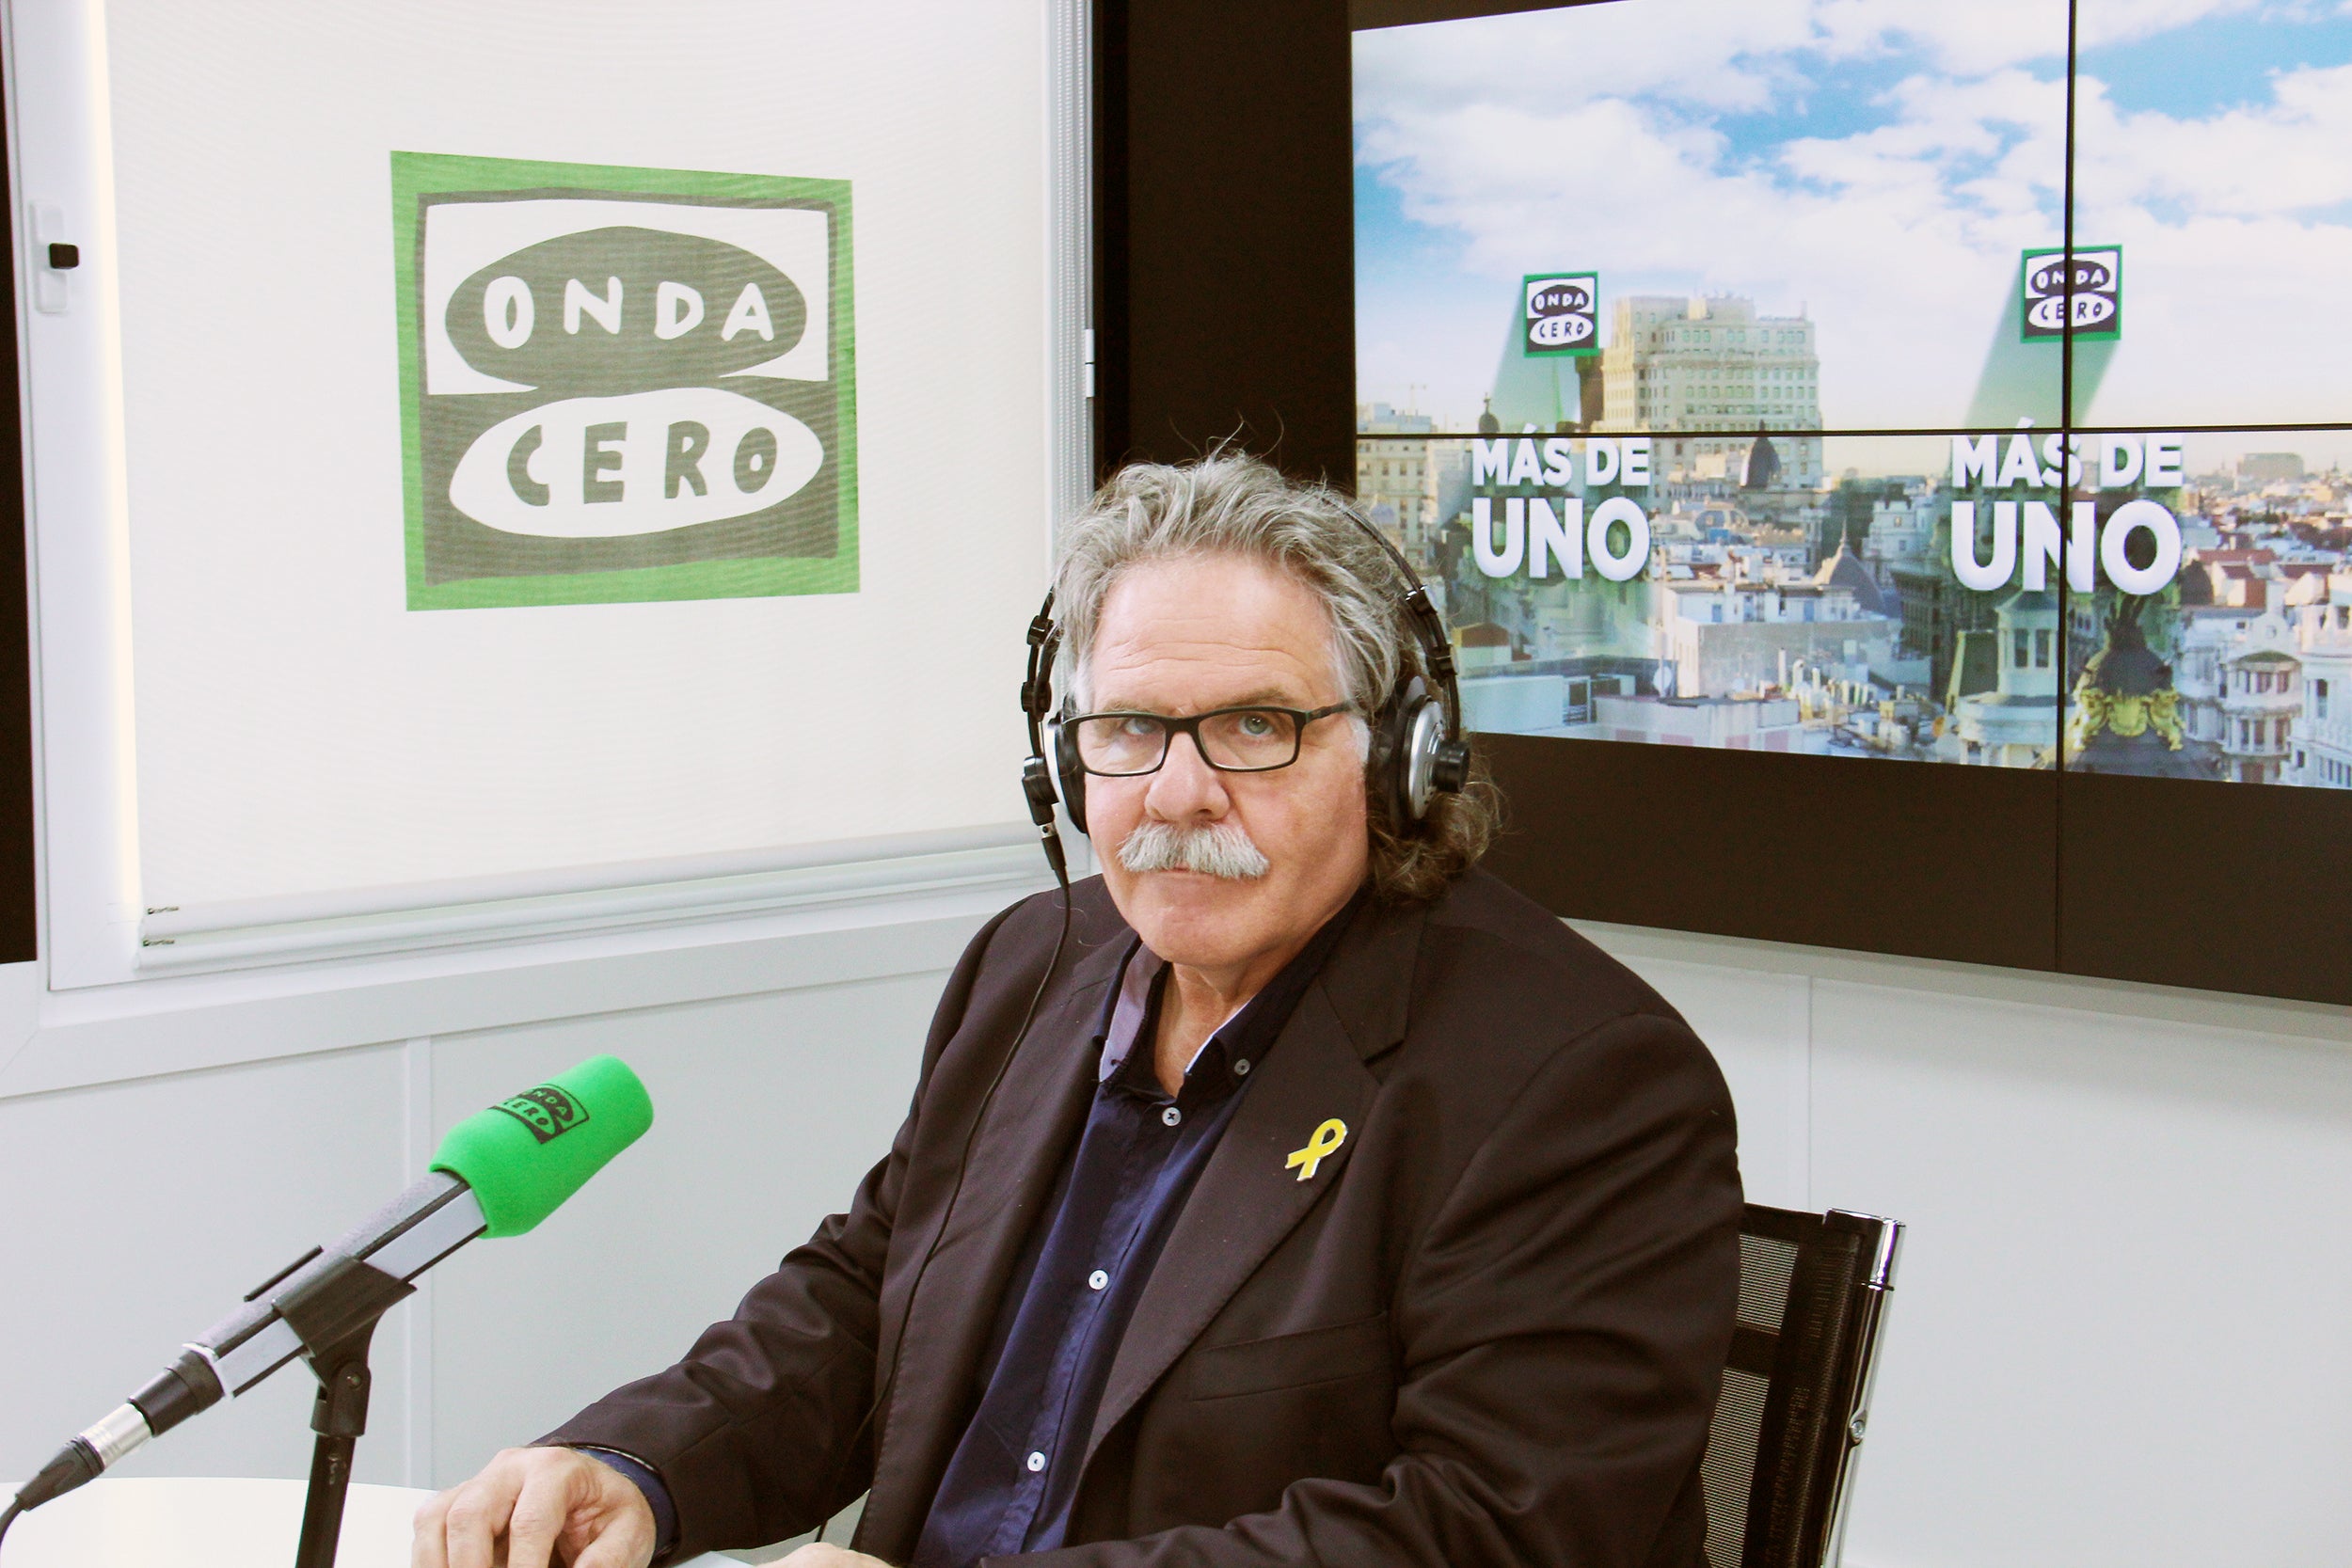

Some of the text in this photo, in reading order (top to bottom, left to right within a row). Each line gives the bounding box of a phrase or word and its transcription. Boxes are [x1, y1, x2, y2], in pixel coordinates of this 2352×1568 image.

[1534, 292, 1585, 311] ONDA
[2036, 268, 2105, 290] ONDA
[2041, 301, 2103, 321] CERO
[483, 275, 775, 350] ONDA
[1539, 321, 1584, 339] CERO
[506, 420, 778, 507] CERO
[1471, 423, 1651, 487] MÁS DE
[1951, 417, 2184, 488] MÁS DE
[1471, 496, 1651, 582] UNO
[1950, 499, 2183, 596] UNO
[522, 1090, 568, 1117] NDA
